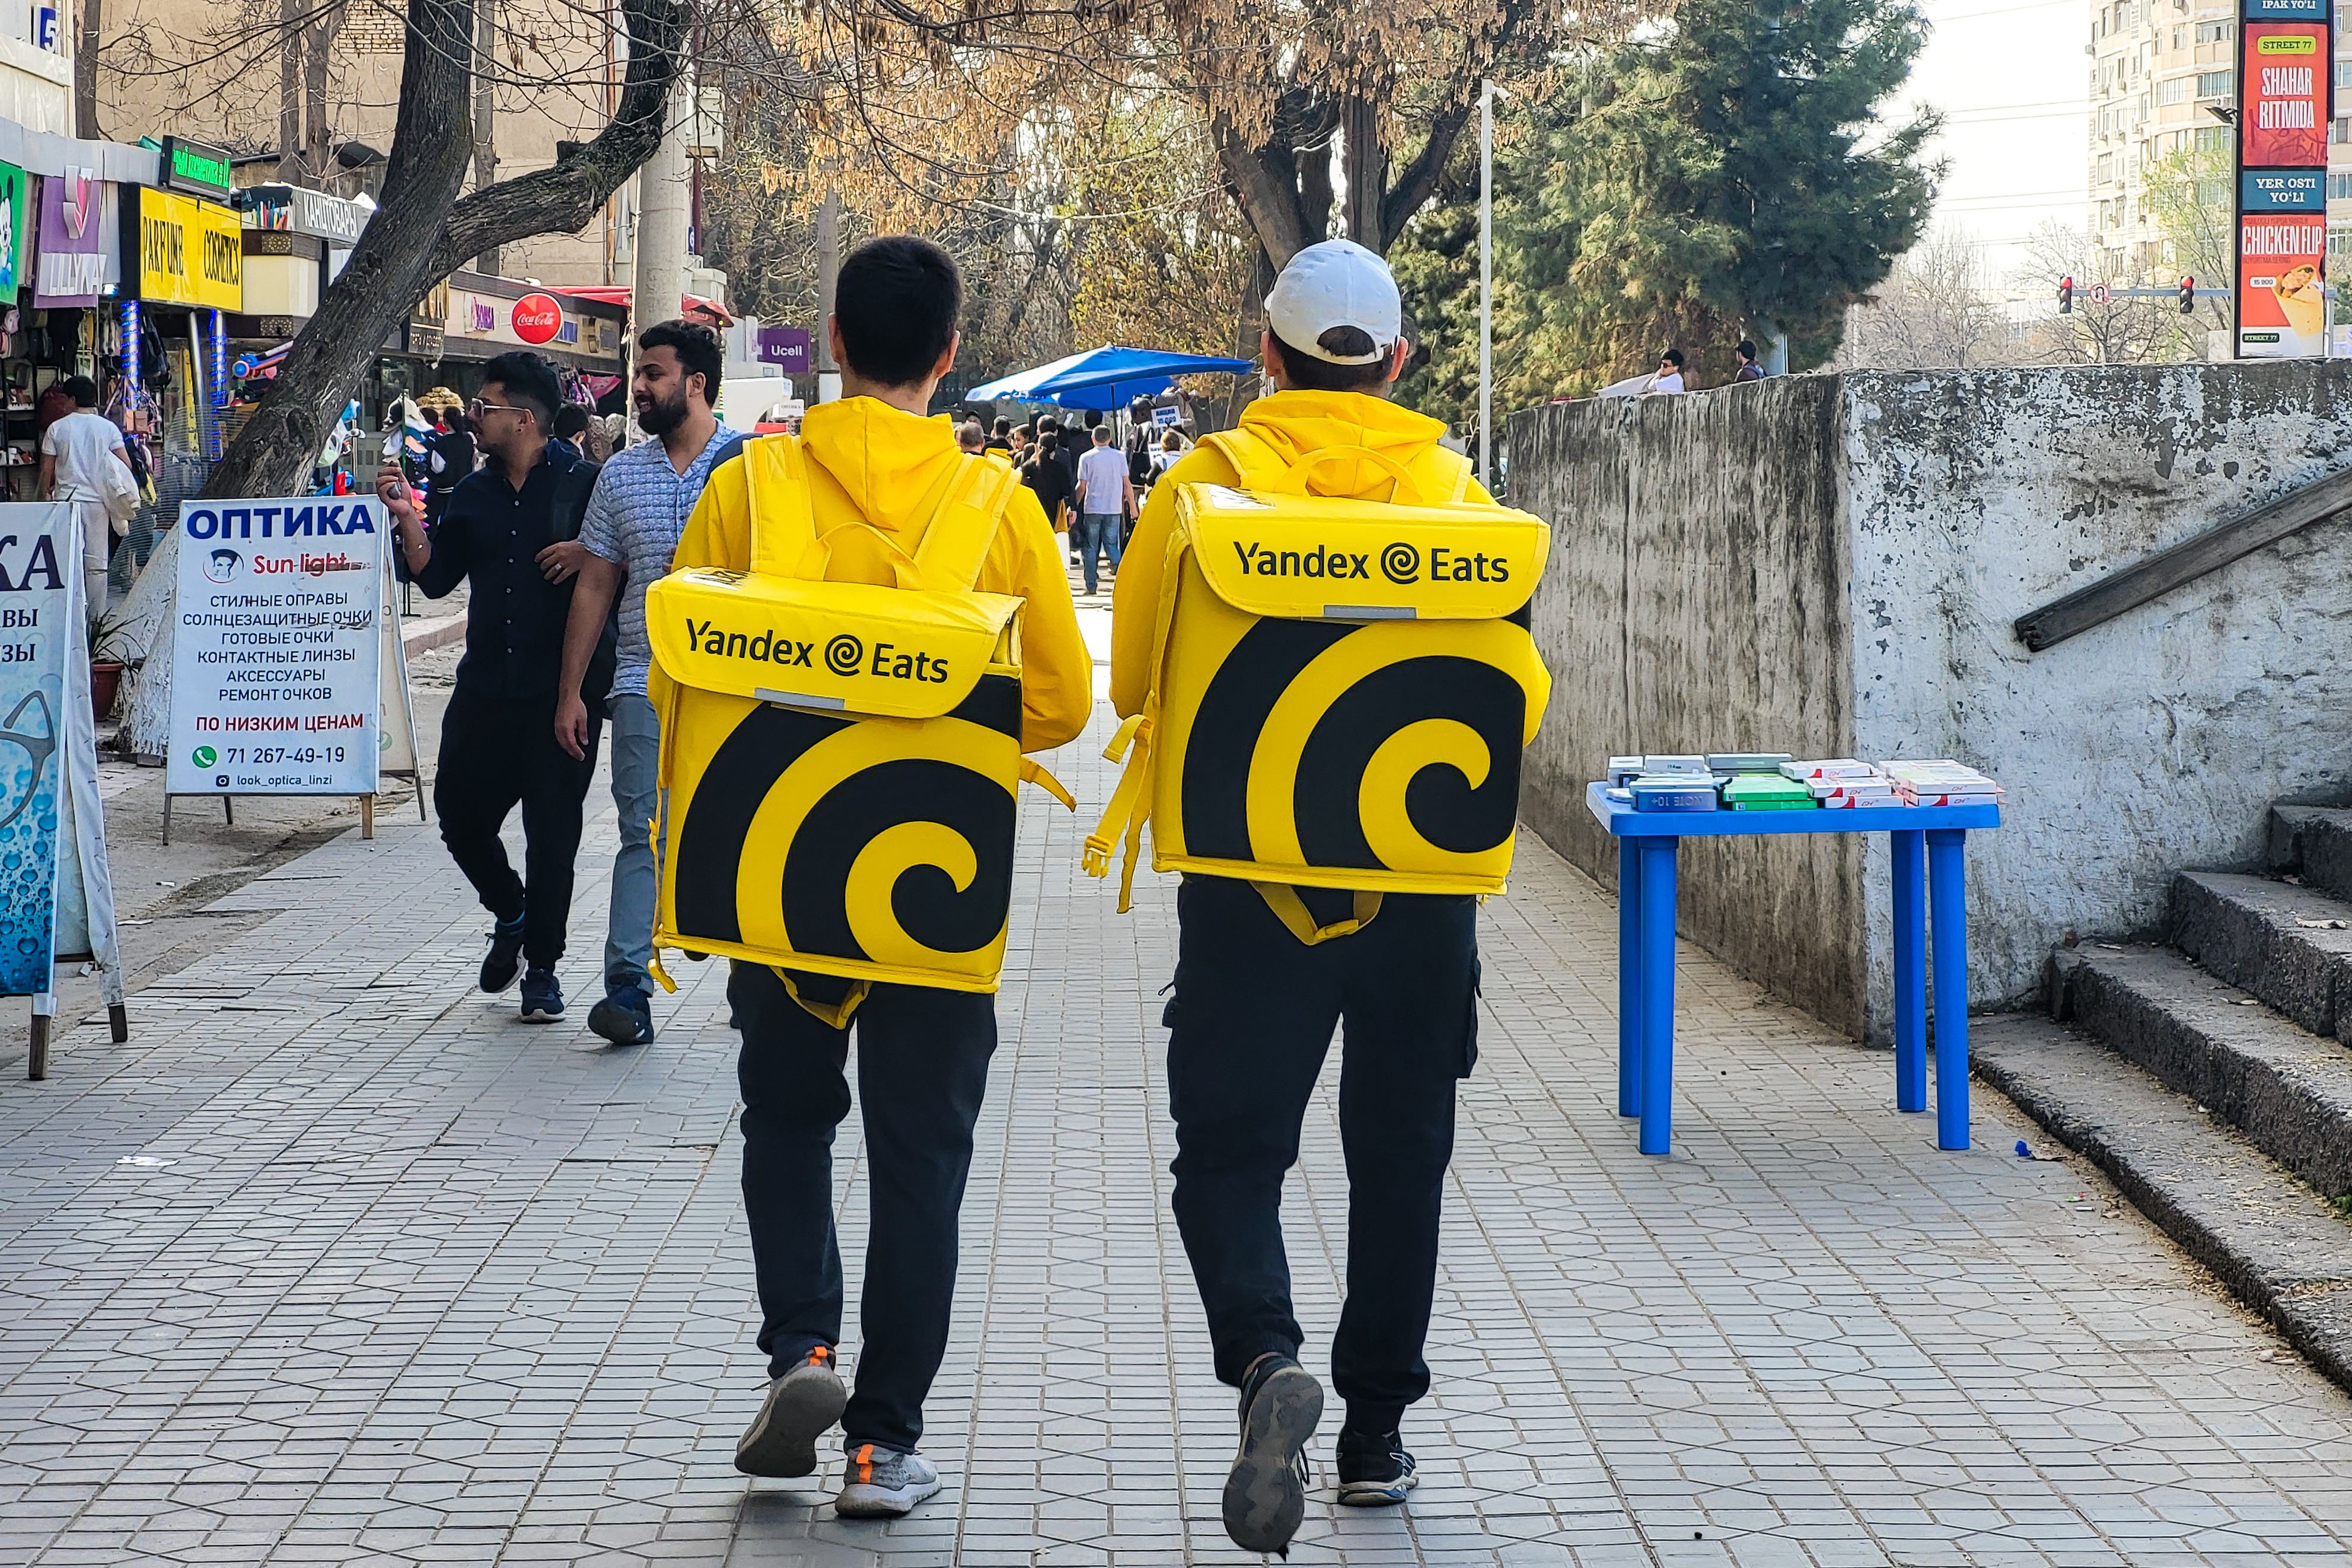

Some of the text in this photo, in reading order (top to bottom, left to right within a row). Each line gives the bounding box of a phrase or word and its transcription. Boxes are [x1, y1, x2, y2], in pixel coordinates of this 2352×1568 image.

[2262, 0, 2289, 9] IPAK
[2261, 67, 2312, 96] SHAHAR
[2259, 100, 2315, 129] RITMIDA
[2256, 178, 2316, 189] YER OSTI
[303, 193, 358, 237] КАНЦТОВАРЫ
[2242, 225, 2322, 255] CHICKEN FLIP
[203, 228, 239, 286] COSMETICS
[771, 344, 802, 356] Ucell
[187, 505, 375, 540] ОПТИКА
[253, 552, 347, 577] Sun light
[1233, 541, 1509, 582] Yandex Eats
[210, 592, 348, 608] СТИЛНЫЕ ОПРАВЫ
[0, 609, 39, 628] ВЫ
[183, 612, 330, 628] СОЛНЦЕЗАЩИТНЫЕ
[333, 610, 372, 624] ОЧКИ
[221, 630, 334, 645] ГОТОВЫЕ ОЧКИ
[0, 643, 36, 662] ЗЫ
[197, 648, 355, 664] КОНТАКТНЫЕ ЛИНЗЫ
[686, 618, 949, 683] Yandex Eats
[226, 668, 325, 683] АКСЕССУАРЫ
[219, 687, 332, 701] РЕМОНТ ОЧКОВ
[196, 713, 364, 733] ПО НИЗКИМ ЦЕНАМ
[227, 747, 345, 764] 71 267-49-19
[237, 775, 332, 788] look_optica_linzi
[1651, 796, 1703, 807] NOTE 10+
